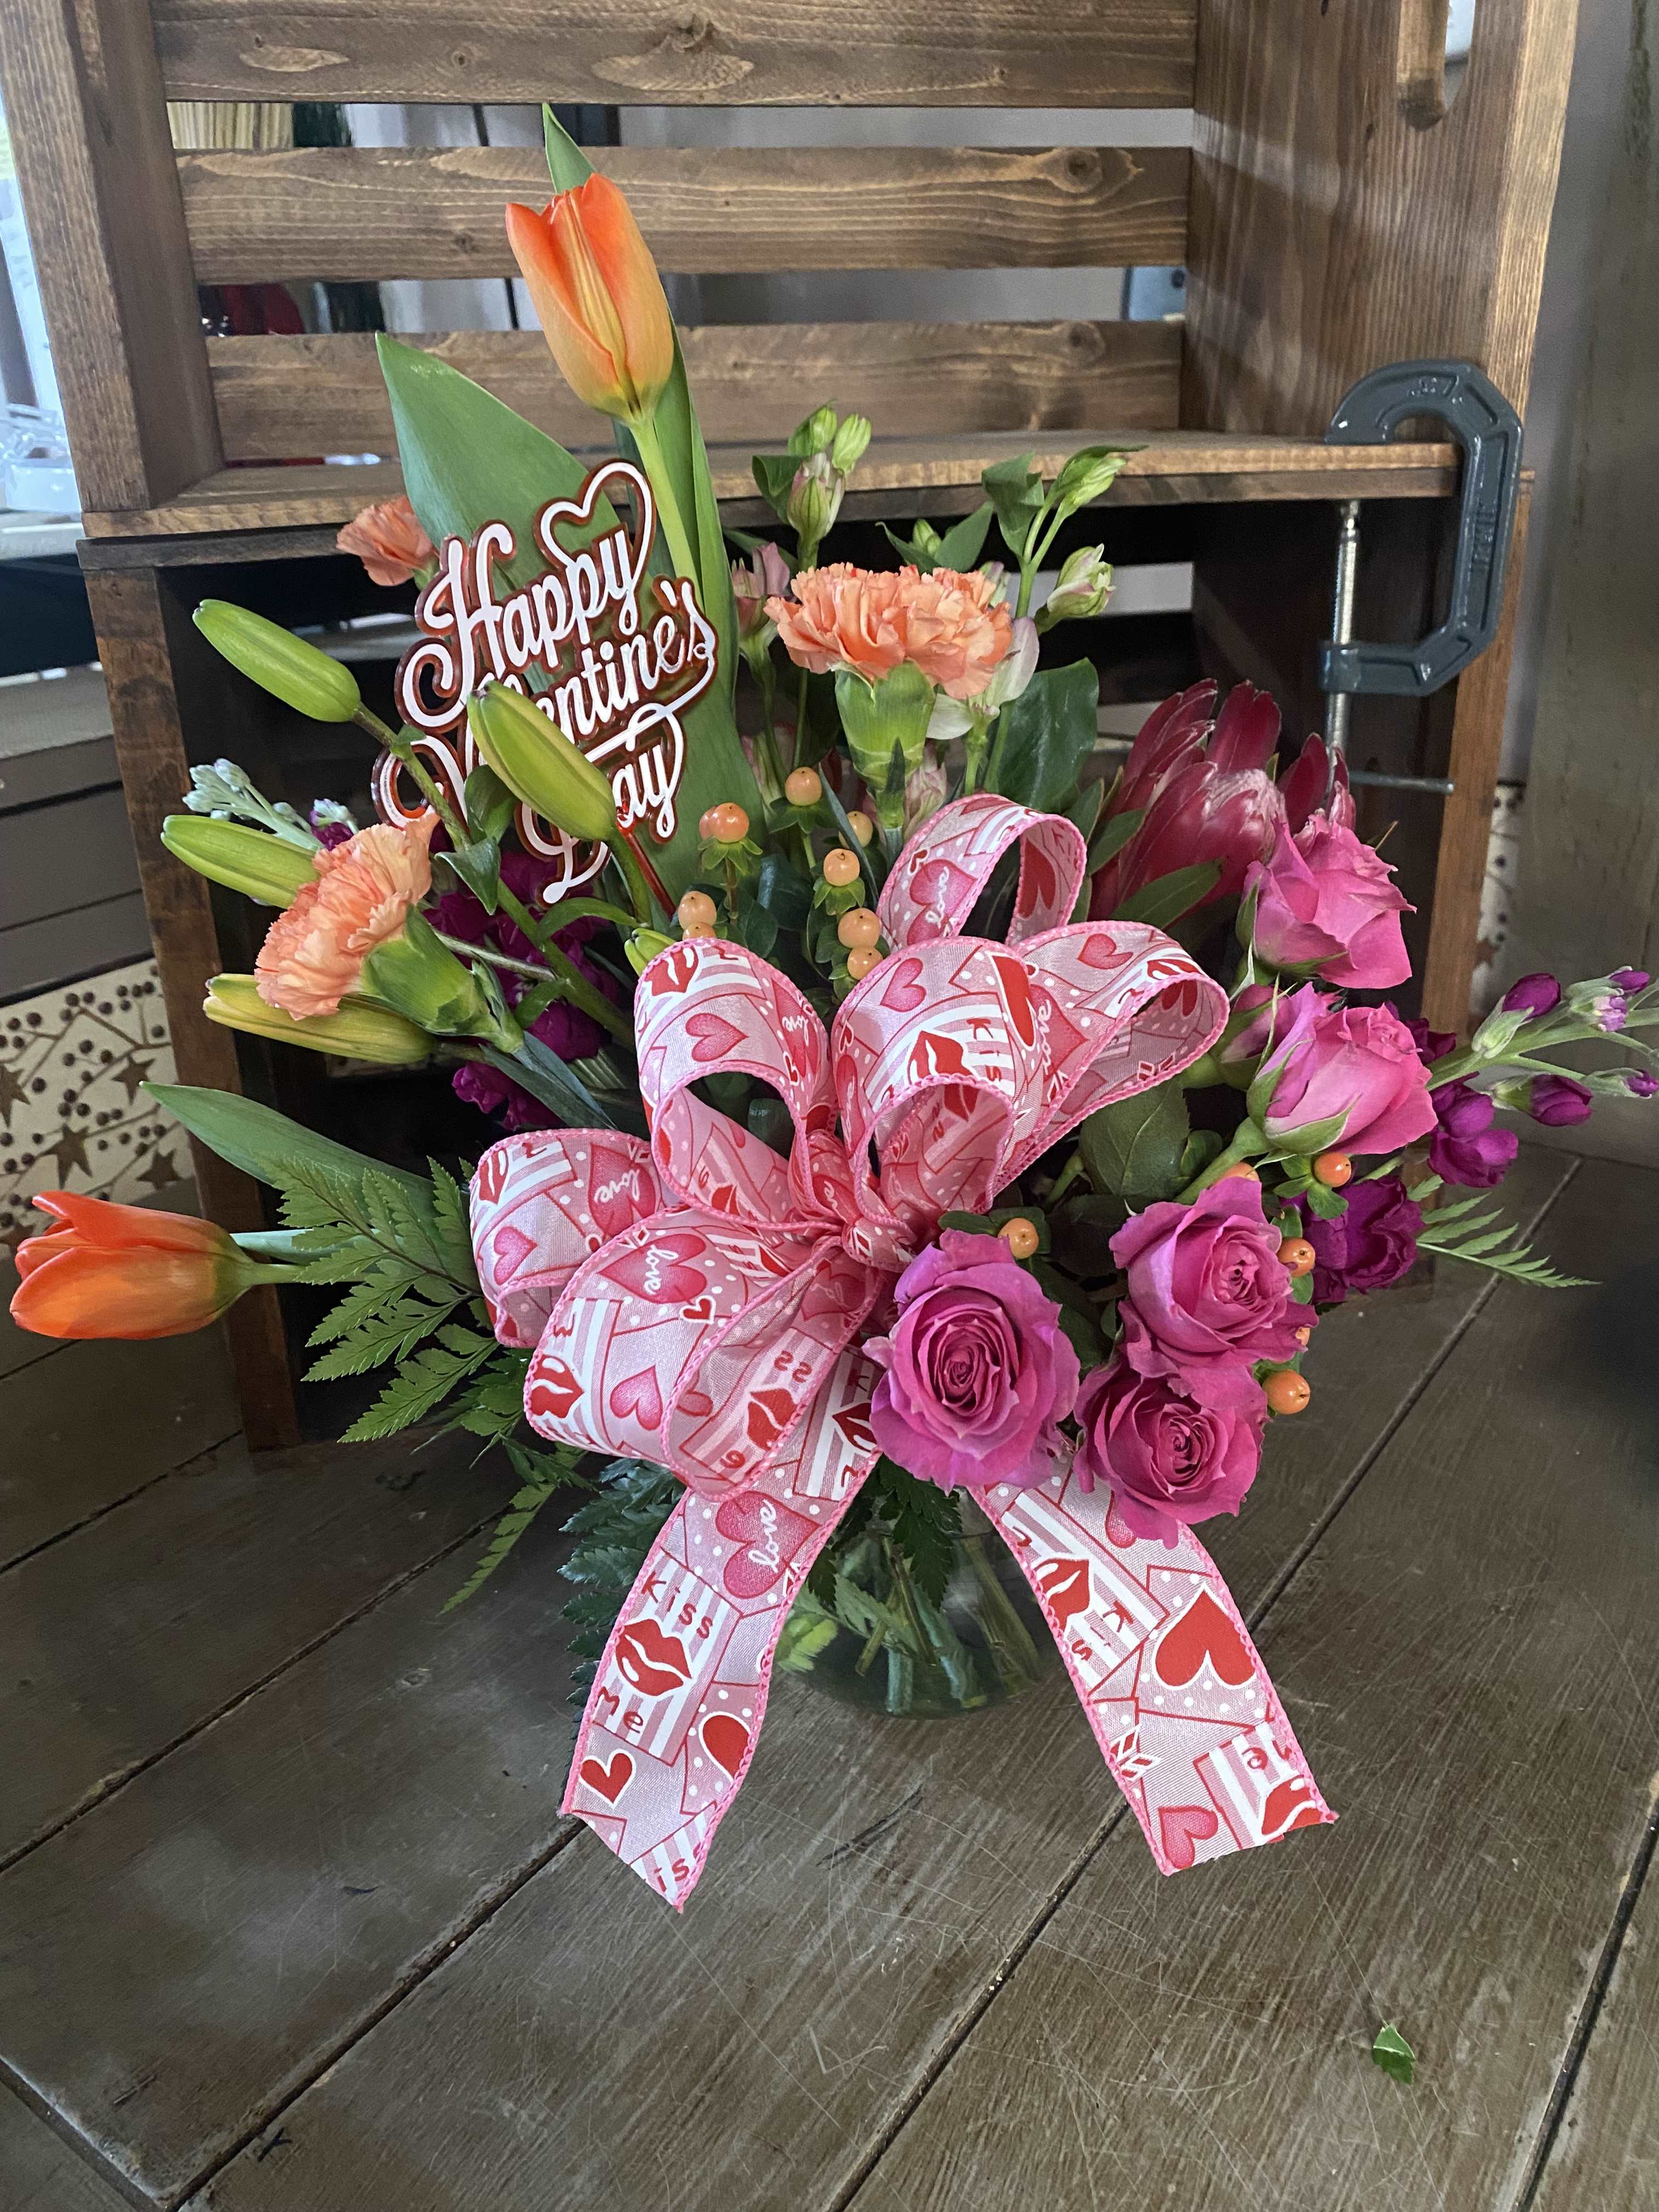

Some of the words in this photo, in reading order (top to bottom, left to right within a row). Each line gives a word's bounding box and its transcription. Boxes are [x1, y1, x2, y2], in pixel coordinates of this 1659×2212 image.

[402, 461, 653, 728] Happy
[782, 1014, 809, 1047] love
[594, 1169, 640, 1204] love
[644, 1244, 679, 1295] love
[748, 1500, 779, 1577] love
[640, 1570, 714, 1639] Kiss
[598, 1685, 644, 1734] Me
